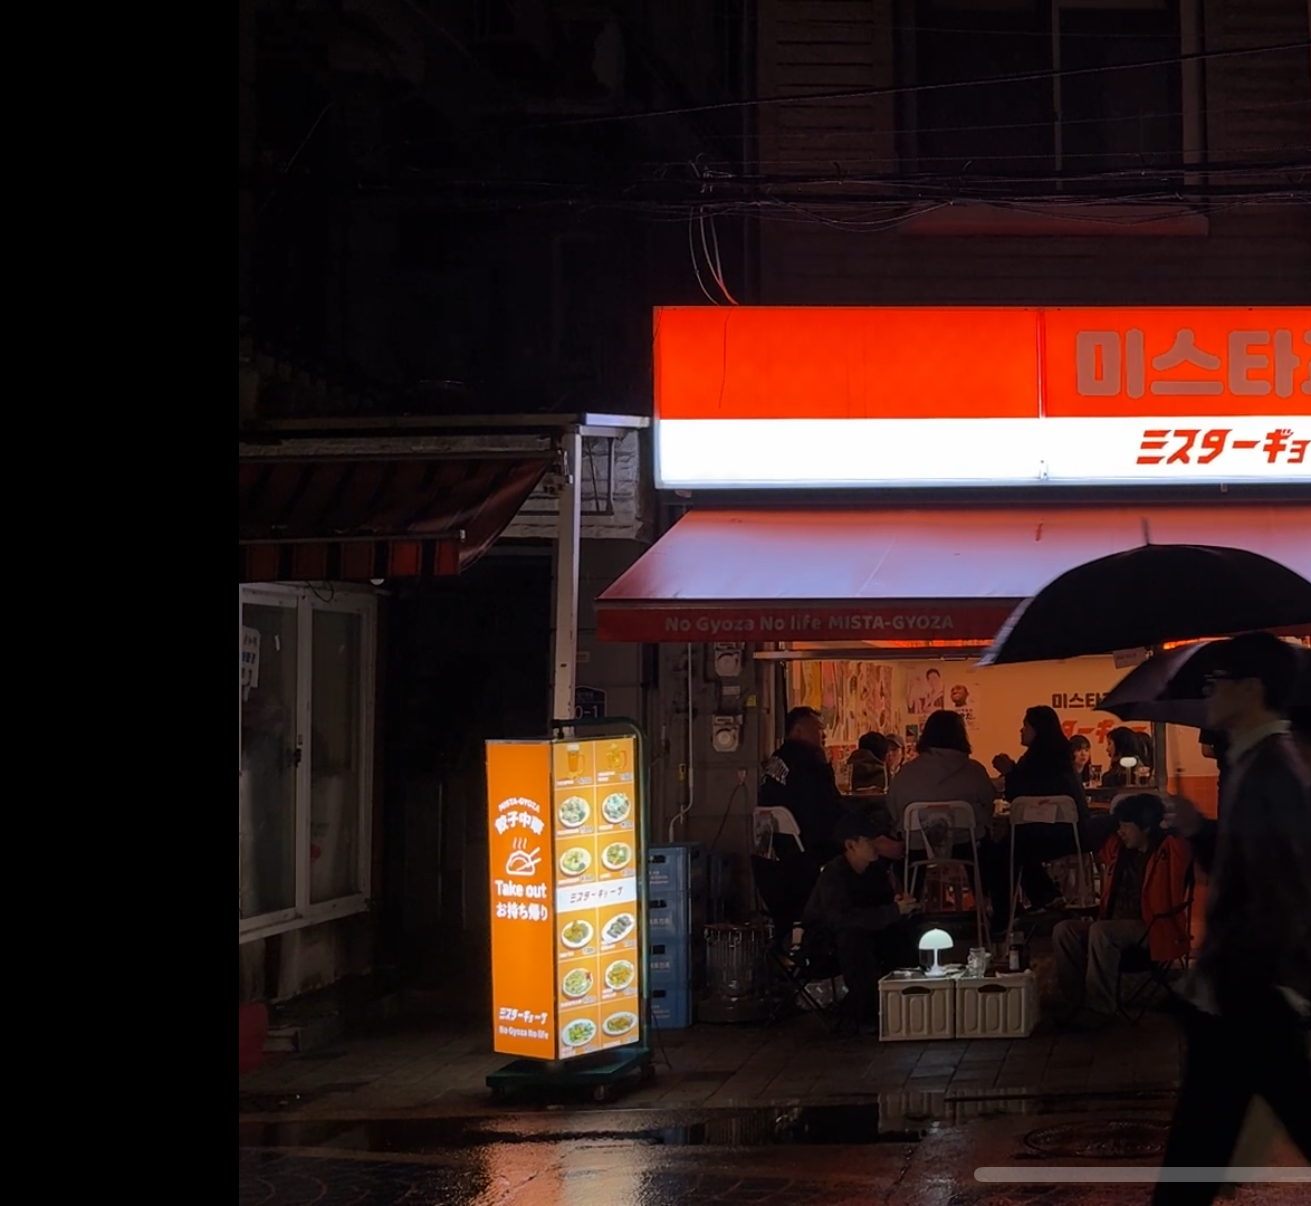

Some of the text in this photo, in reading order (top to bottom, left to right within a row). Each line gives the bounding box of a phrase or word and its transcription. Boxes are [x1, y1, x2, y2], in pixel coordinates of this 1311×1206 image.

[665, 614, 954, 635] No Gyoza No life MISTA-GYOZA
[495, 879, 547, 899] Take out
[496, 902, 548, 921] お持ち帰り
